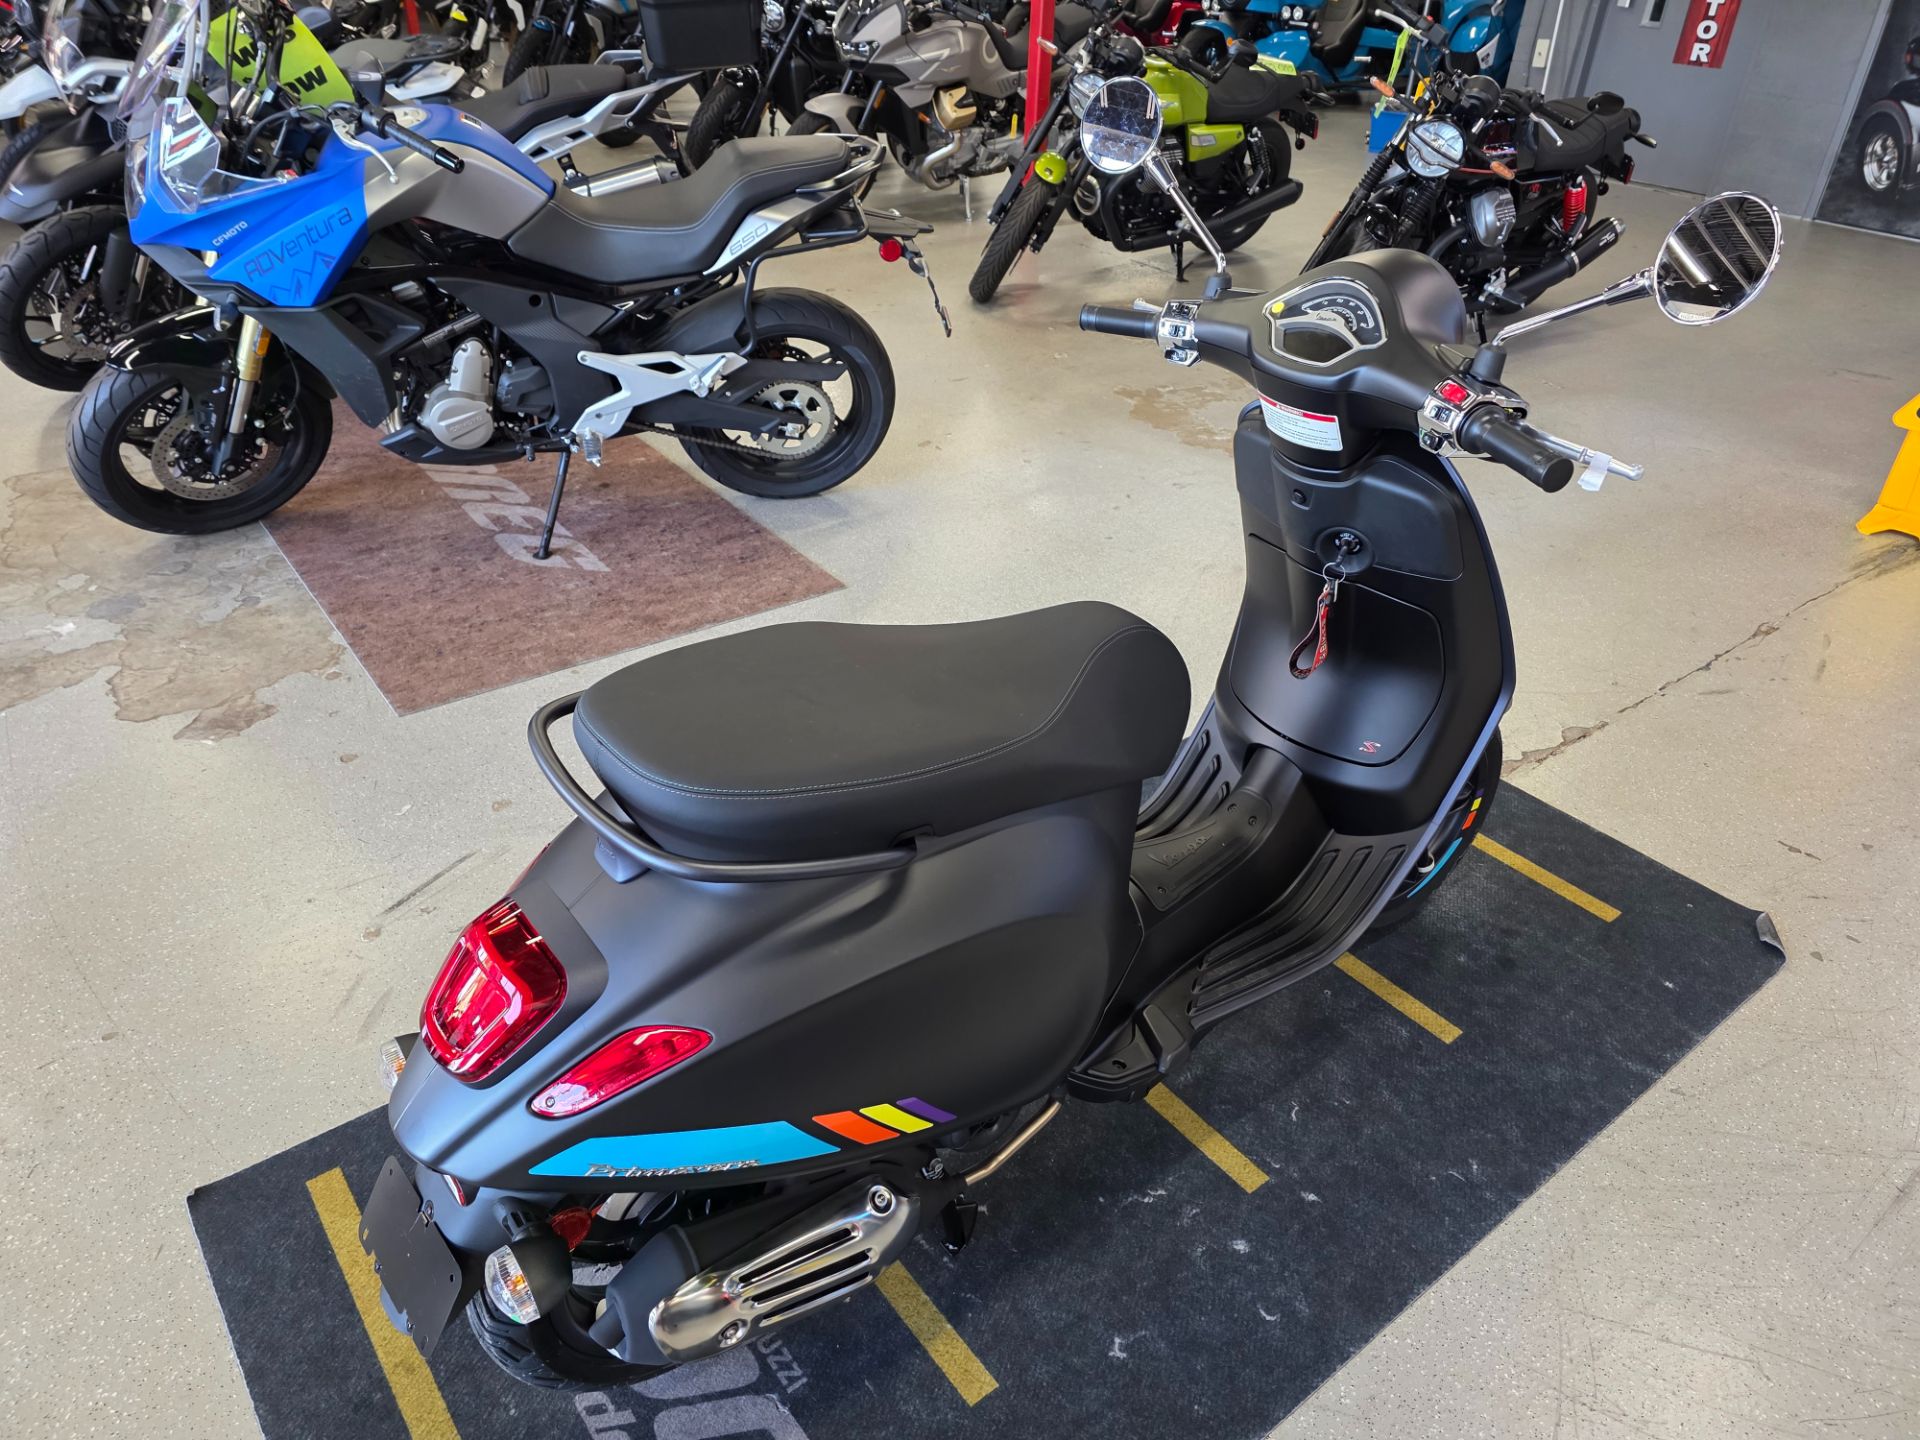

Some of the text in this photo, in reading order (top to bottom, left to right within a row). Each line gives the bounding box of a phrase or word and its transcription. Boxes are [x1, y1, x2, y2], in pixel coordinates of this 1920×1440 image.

[212, 220, 249, 247] CFMOTO
[729, 222, 769, 256] 650
[757, 1332, 808, 1393] UZZI
